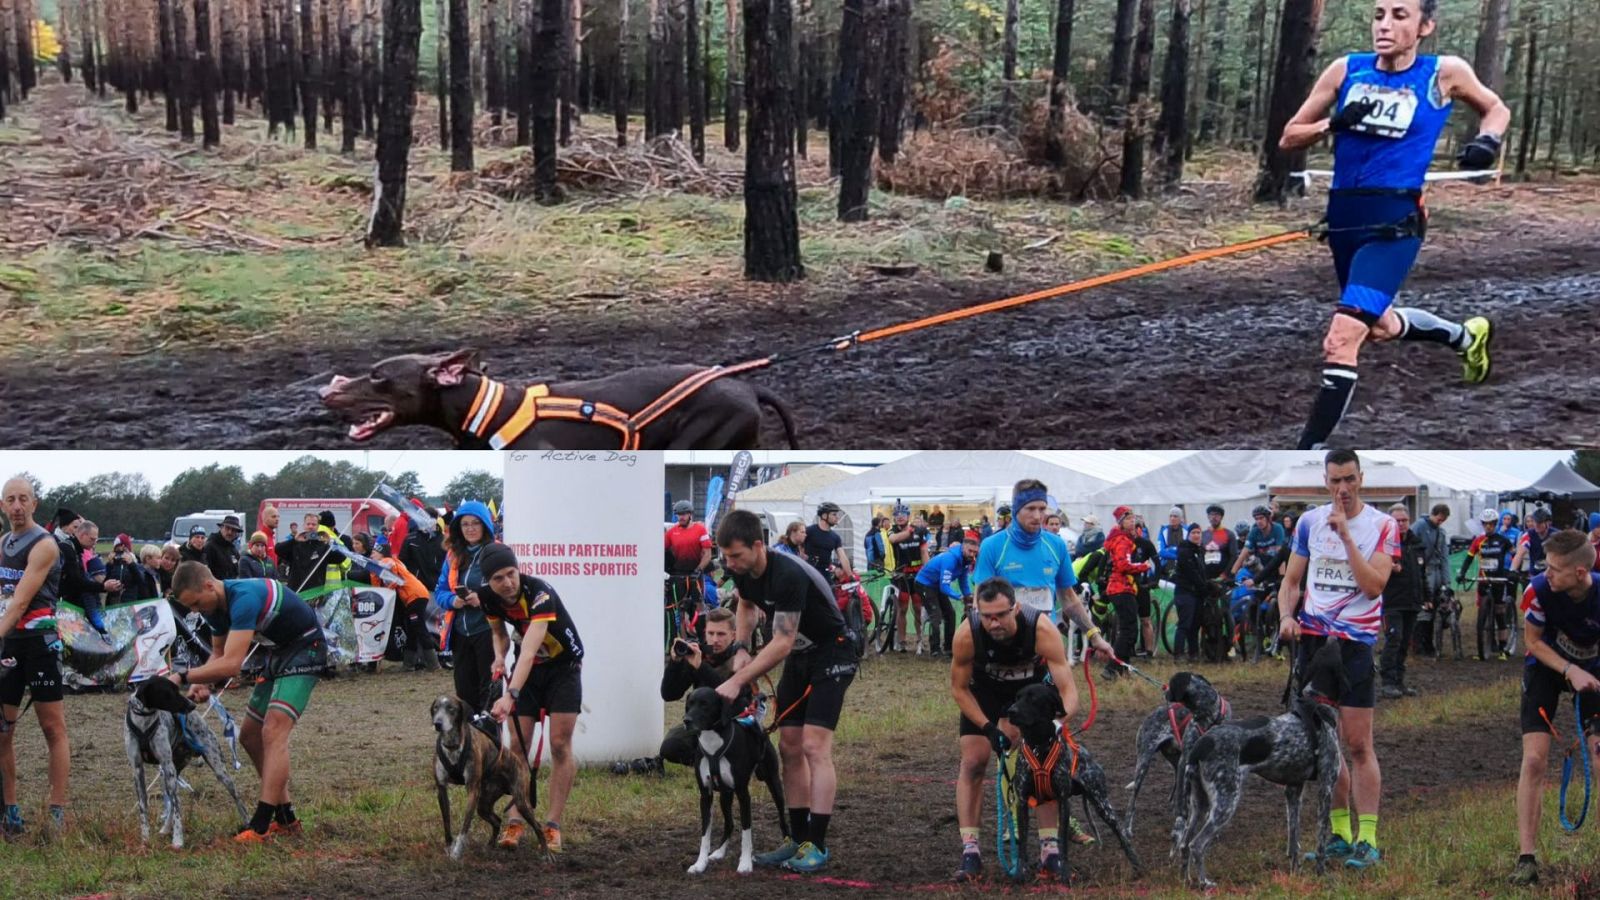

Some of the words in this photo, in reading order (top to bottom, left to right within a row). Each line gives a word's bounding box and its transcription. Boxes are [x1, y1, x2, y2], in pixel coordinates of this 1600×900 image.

[541, 450, 597, 461] Active
[604, 450, 638, 467] Dog
[533, 544, 565, 556] CHIEN
[569, 544, 638, 557] PARTENAIRE
[536, 562, 580, 575] LOISIRS
[584, 562, 638, 576] SPORTIFS
[1317, 567, 1342, 580] FRA
